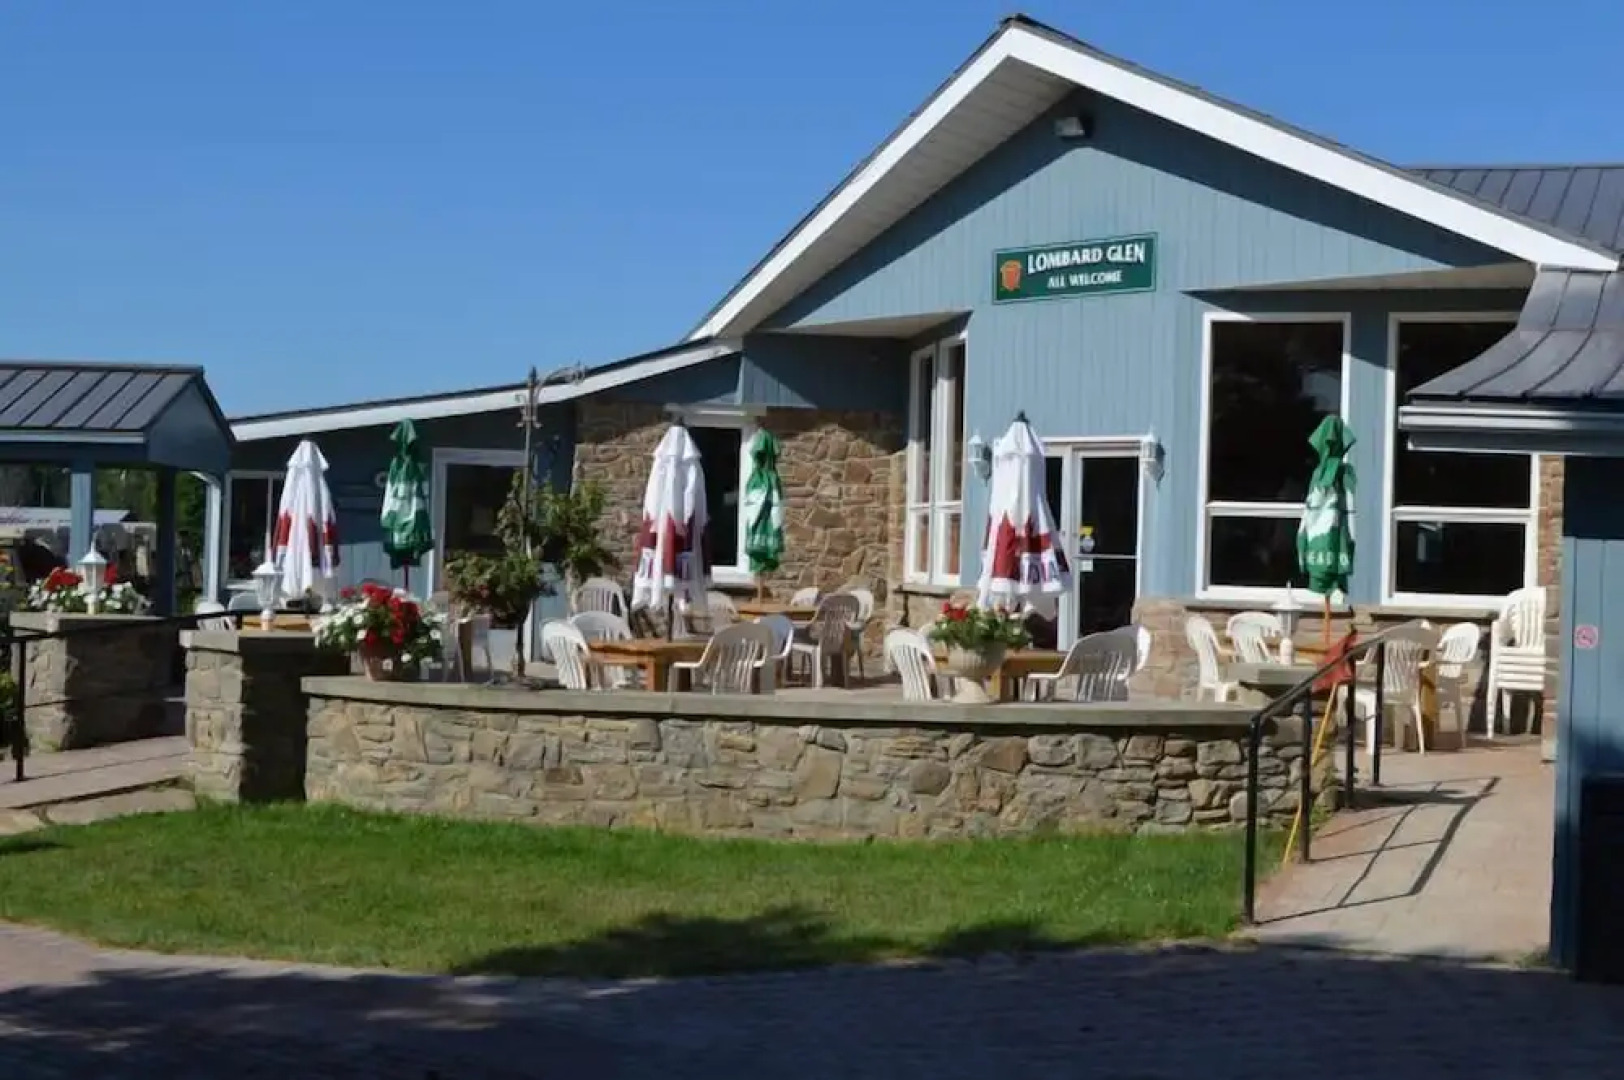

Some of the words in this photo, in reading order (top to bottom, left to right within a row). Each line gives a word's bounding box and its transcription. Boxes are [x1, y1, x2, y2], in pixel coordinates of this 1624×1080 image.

[1027, 247, 1103, 274] LOMBARD
[1106, 242, 1146, 263] GLEN
[1047, 273, 1066, 289] ALL
[1069, 270, 1123, 287] WELCOME
